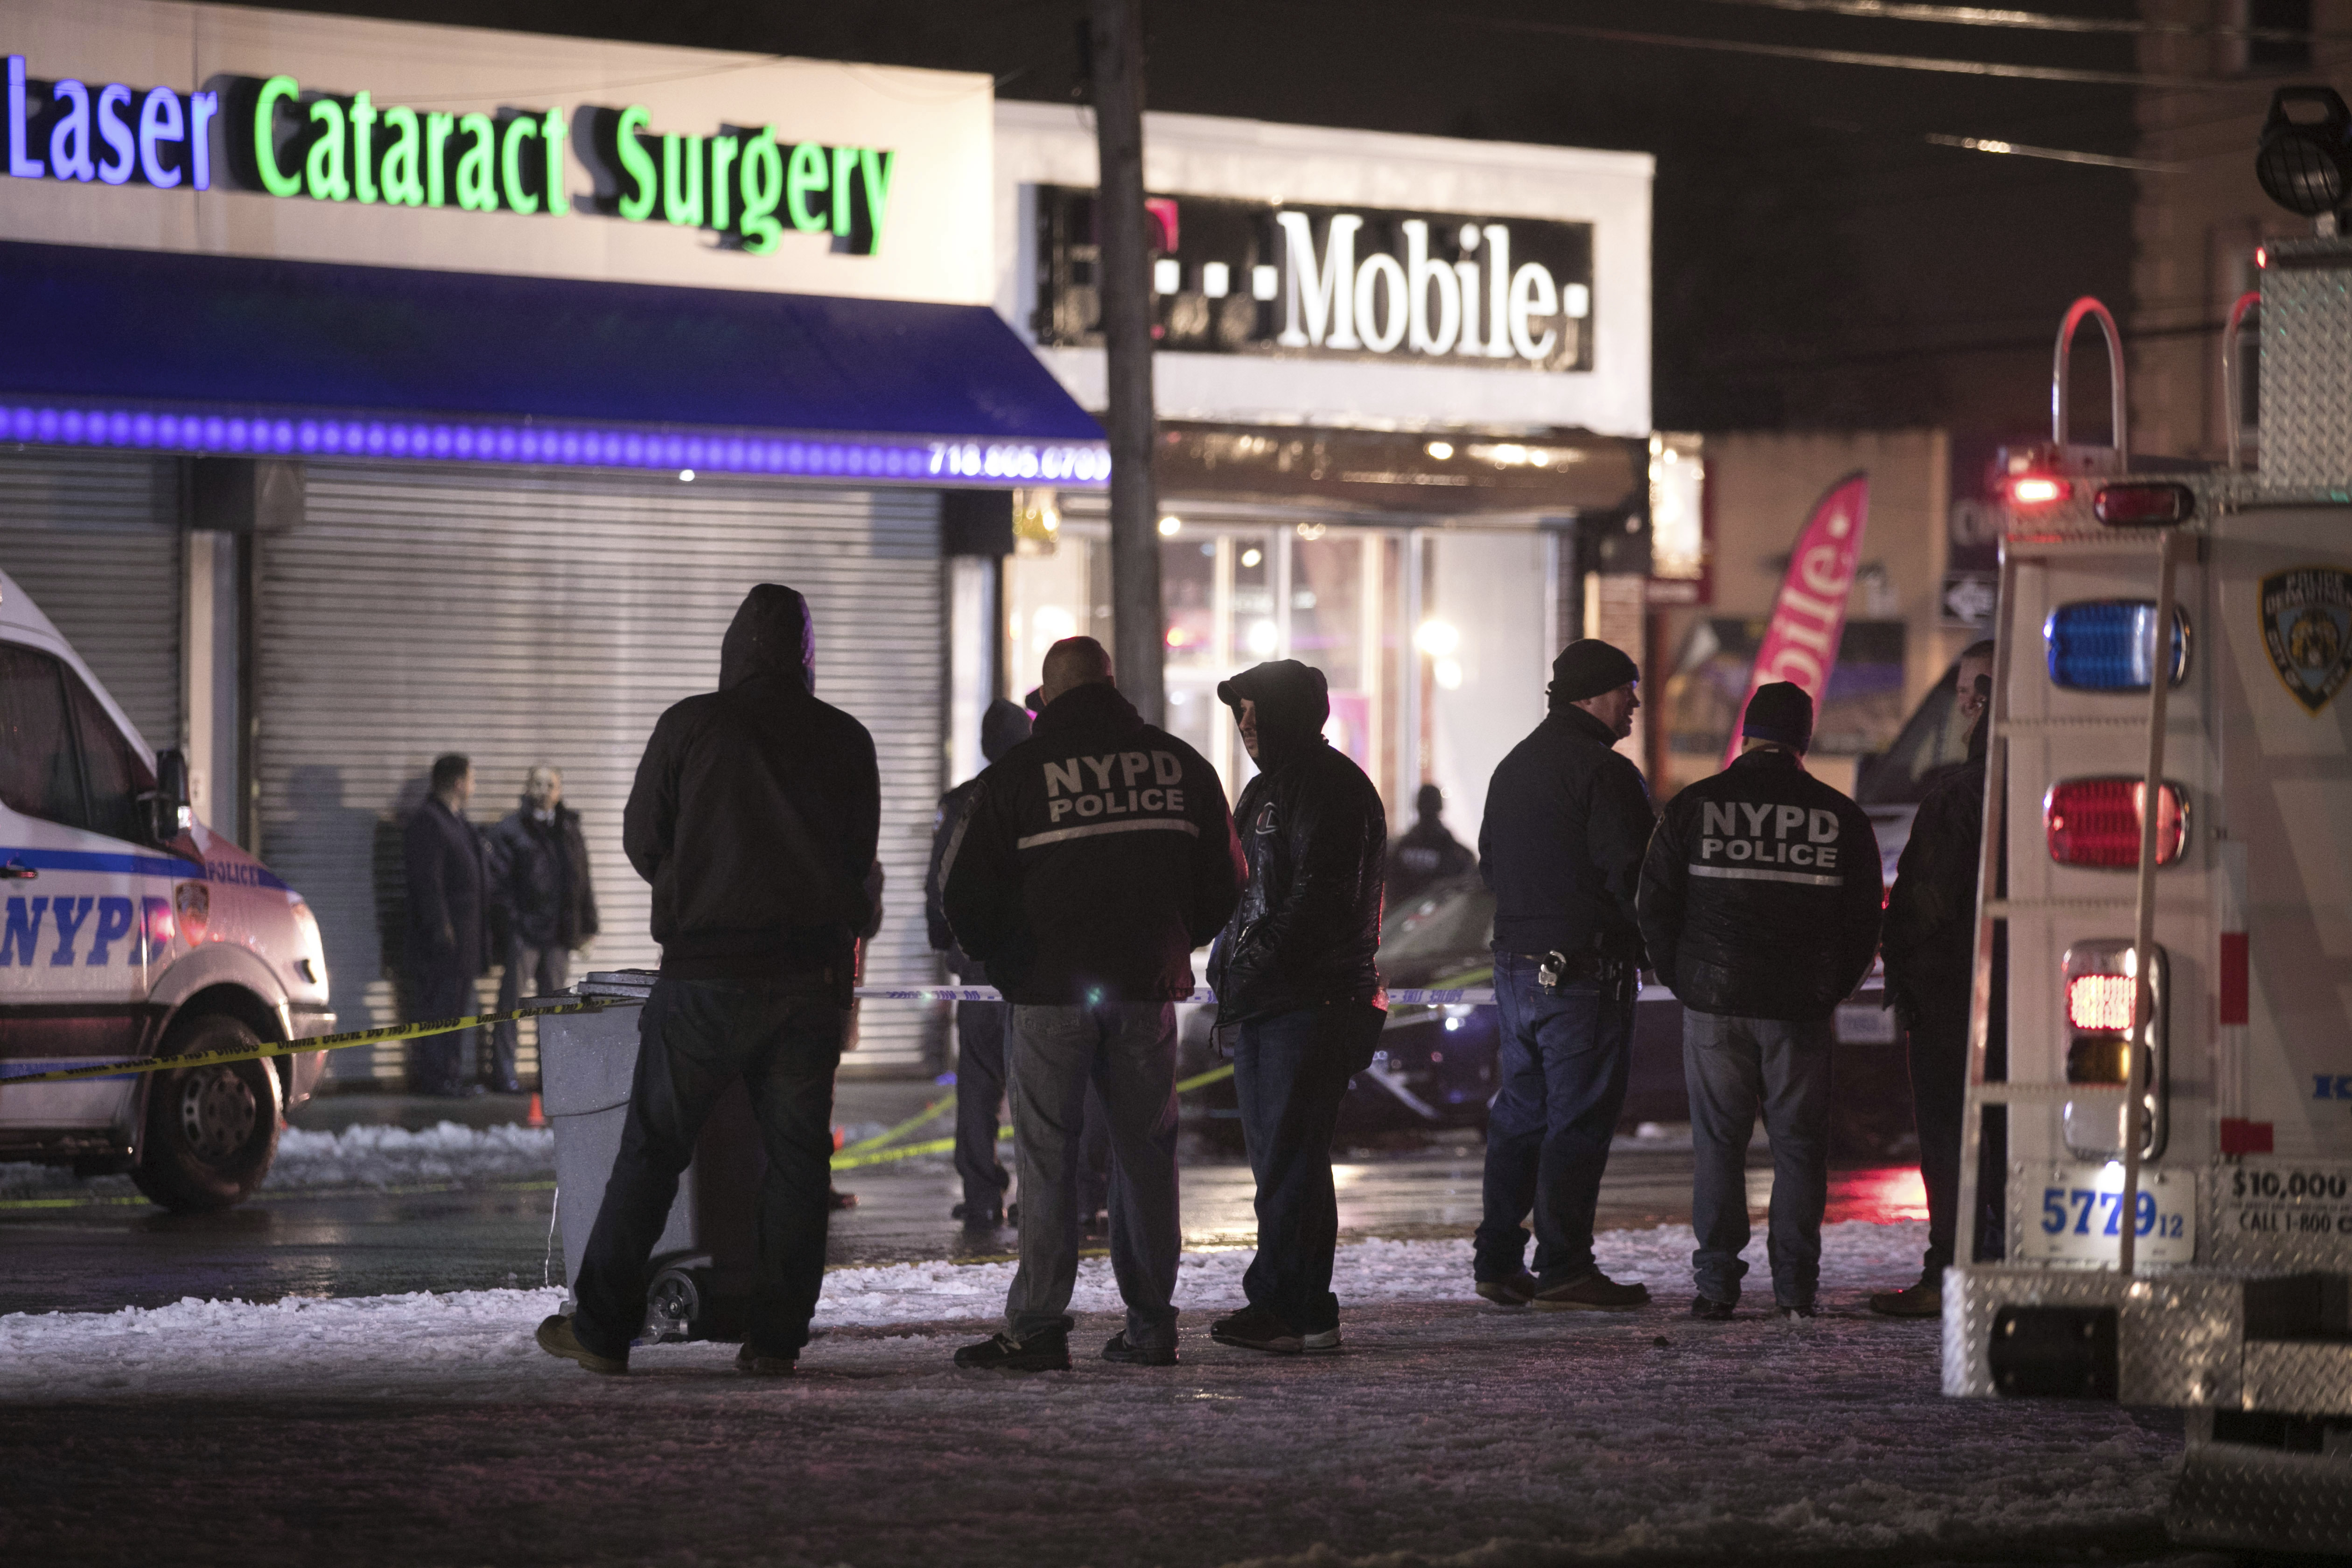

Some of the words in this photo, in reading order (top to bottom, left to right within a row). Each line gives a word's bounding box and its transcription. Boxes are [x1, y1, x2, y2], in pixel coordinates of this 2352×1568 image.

[8, 54, 218, 190] Laser
[254, 74, 570, 217] Cataract
[616, 104, 896, 256] Surgery
[1276, 210, 1559, 360] Mobile
[1043, 749, 1183, 798] NYPD
[1049, 789, 1184, 823] POLICE
[1702, 801, 1840, 844] NYPD
[1702, 838, 1838, 868] POLICE
[0, 896, 173, 966] NYPD
[2233, 1169, 2347, 1199] $10,000
[2159, 1214, 2184, 1238] 12
[2240, 1212, 2278, 1232] CALL
